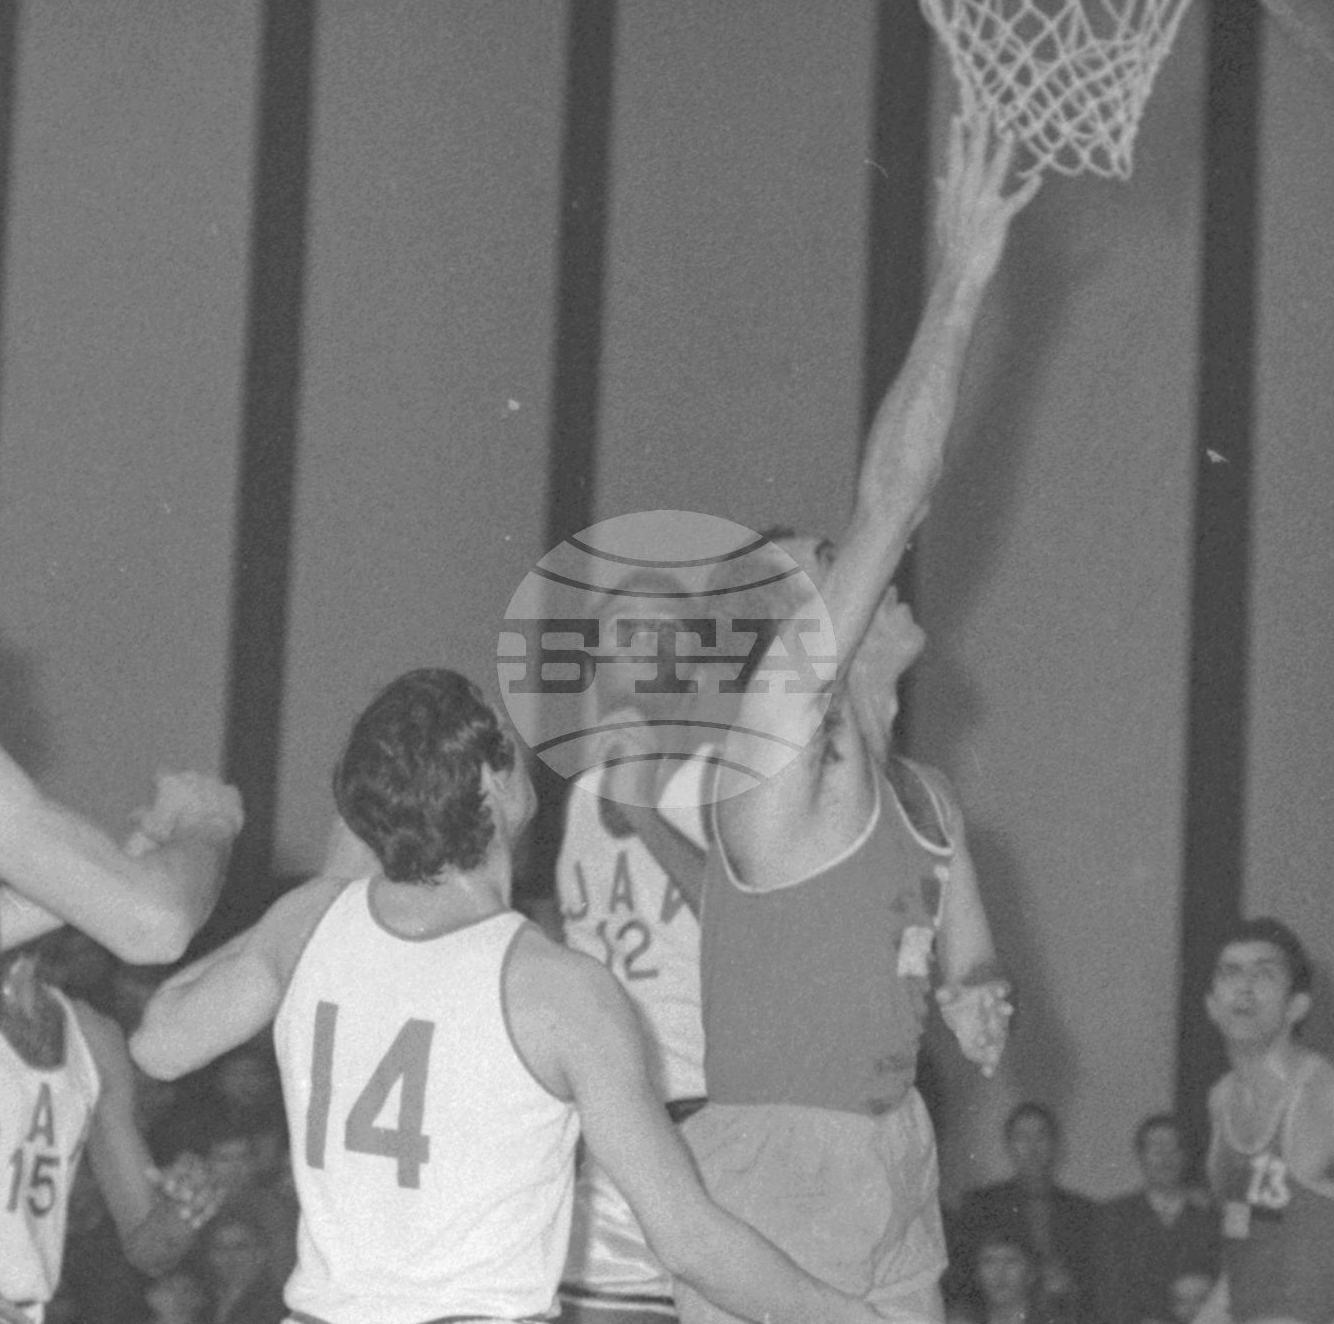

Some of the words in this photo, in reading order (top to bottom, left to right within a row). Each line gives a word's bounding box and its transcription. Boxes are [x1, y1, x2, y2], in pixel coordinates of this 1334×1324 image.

[595, 919, 660, 981] 12
[305, 999, 436, 1190] 14
[7, 1148, 61, 1218] 15
